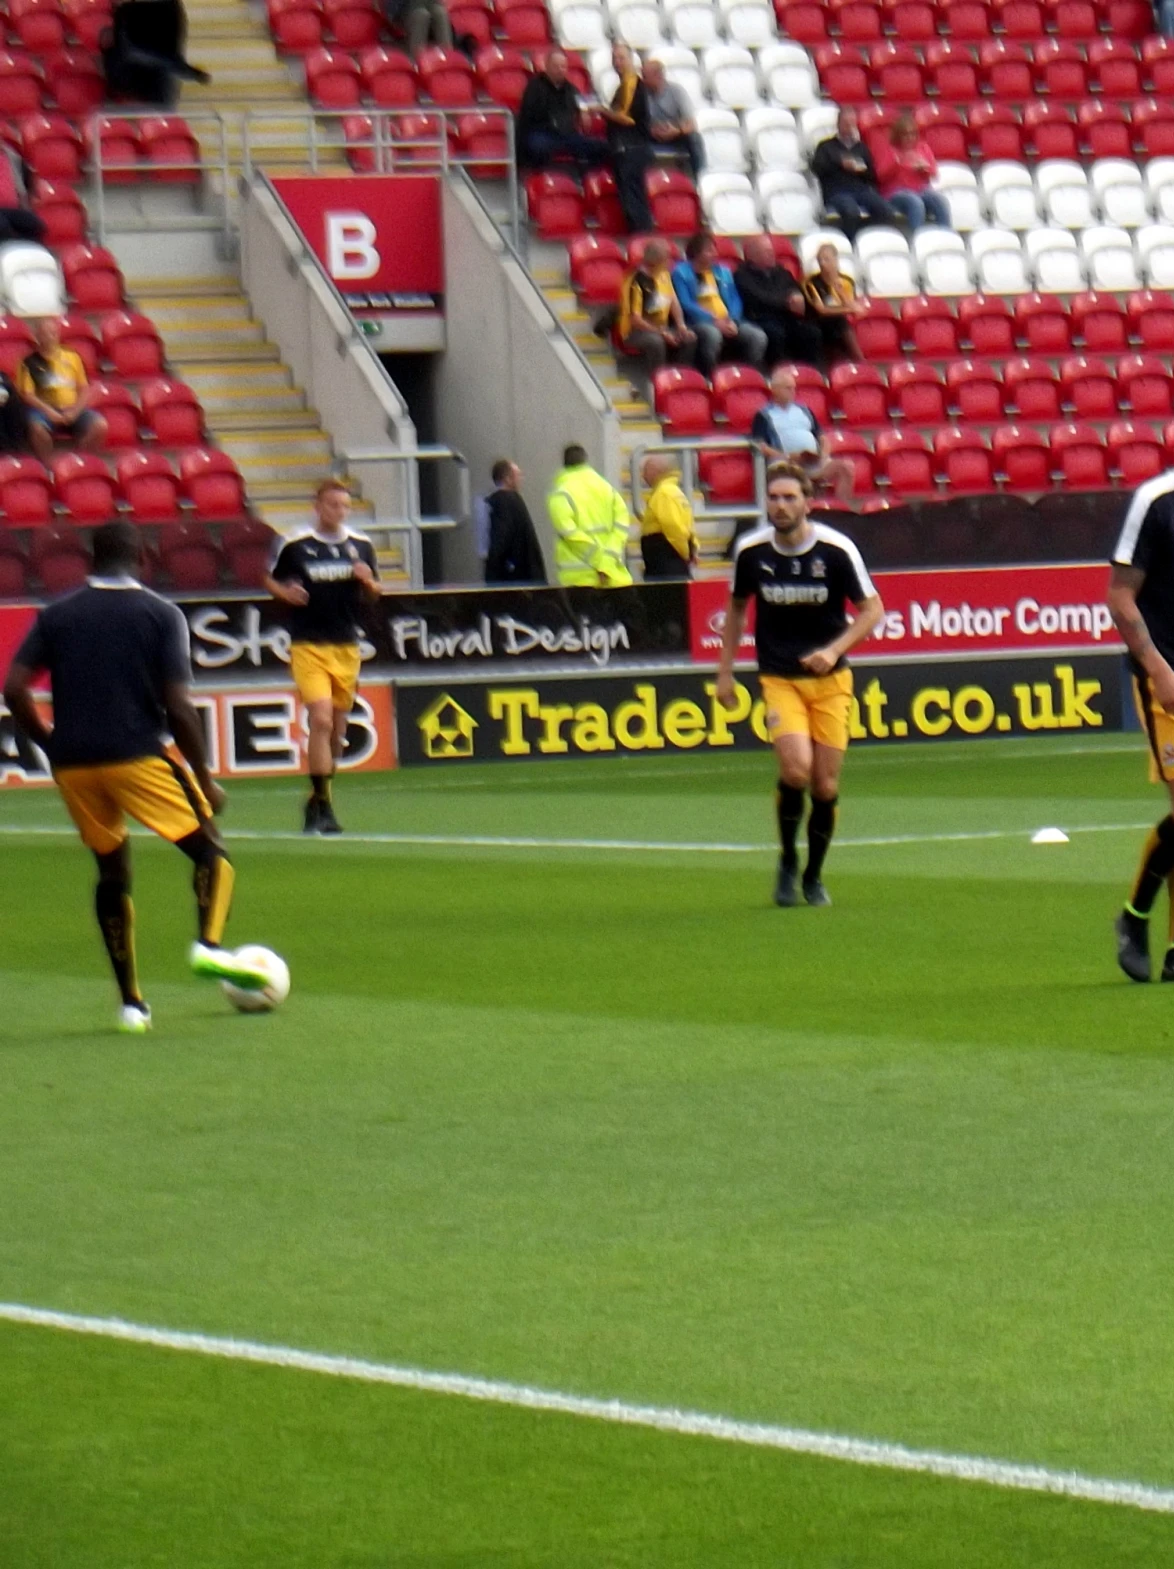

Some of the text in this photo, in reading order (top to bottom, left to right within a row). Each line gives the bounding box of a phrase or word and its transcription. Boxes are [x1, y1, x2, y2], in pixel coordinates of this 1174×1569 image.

[325, 210, 381, 279] B
[391, 612, 494, 660] Floral
[496, 612, 631, 668] Design
[910, 599, 1010, 639] Motor
[1014, 597, 1118, 641] Comp
[487, 663, 1104, 756] TradePt.co.uk
